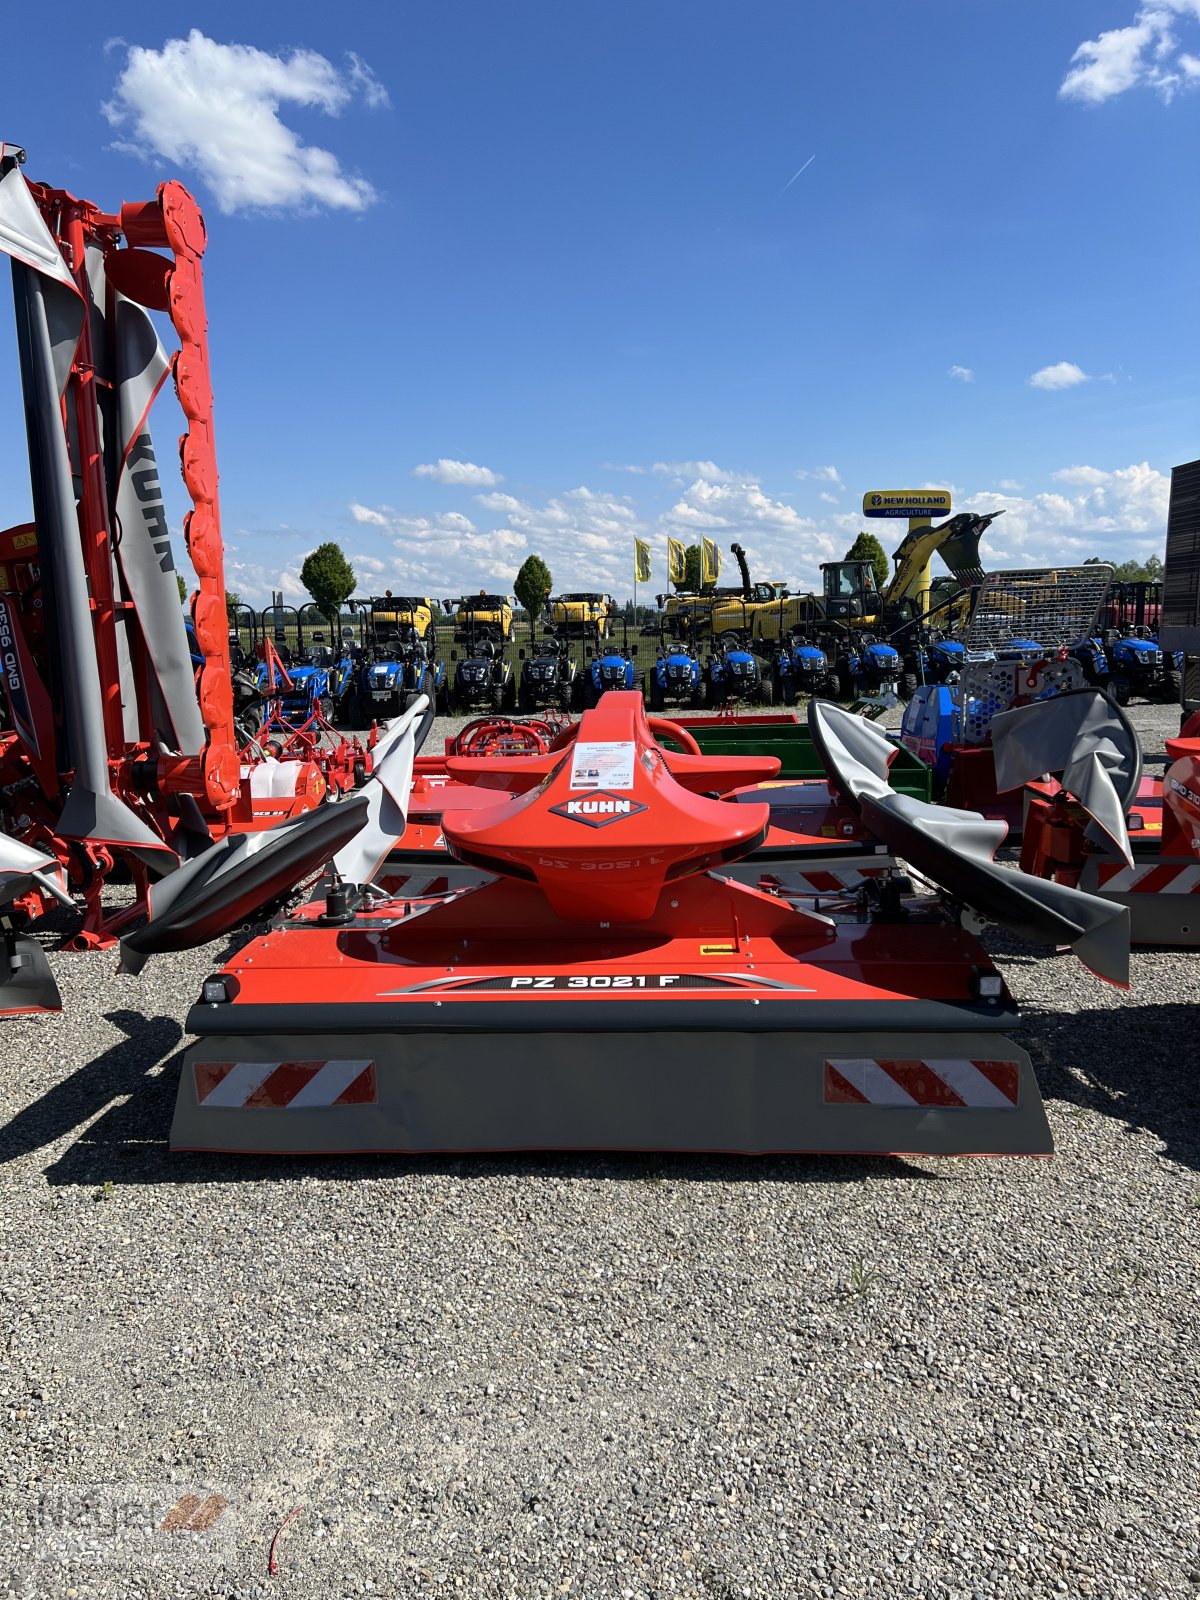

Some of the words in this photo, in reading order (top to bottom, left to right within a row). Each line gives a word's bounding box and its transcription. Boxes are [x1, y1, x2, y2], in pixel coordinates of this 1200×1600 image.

[126, 433, 175, 573] KUHN
[905, 496, 946, 504] HOLLAND
[4, 652, 21, 691] GMD
[567, 800, 631, 813] KUHN
[511, 977, 555, 988] PZ
[568, 976, 646, 988] 3021
[659, 975, 680, 987] F
